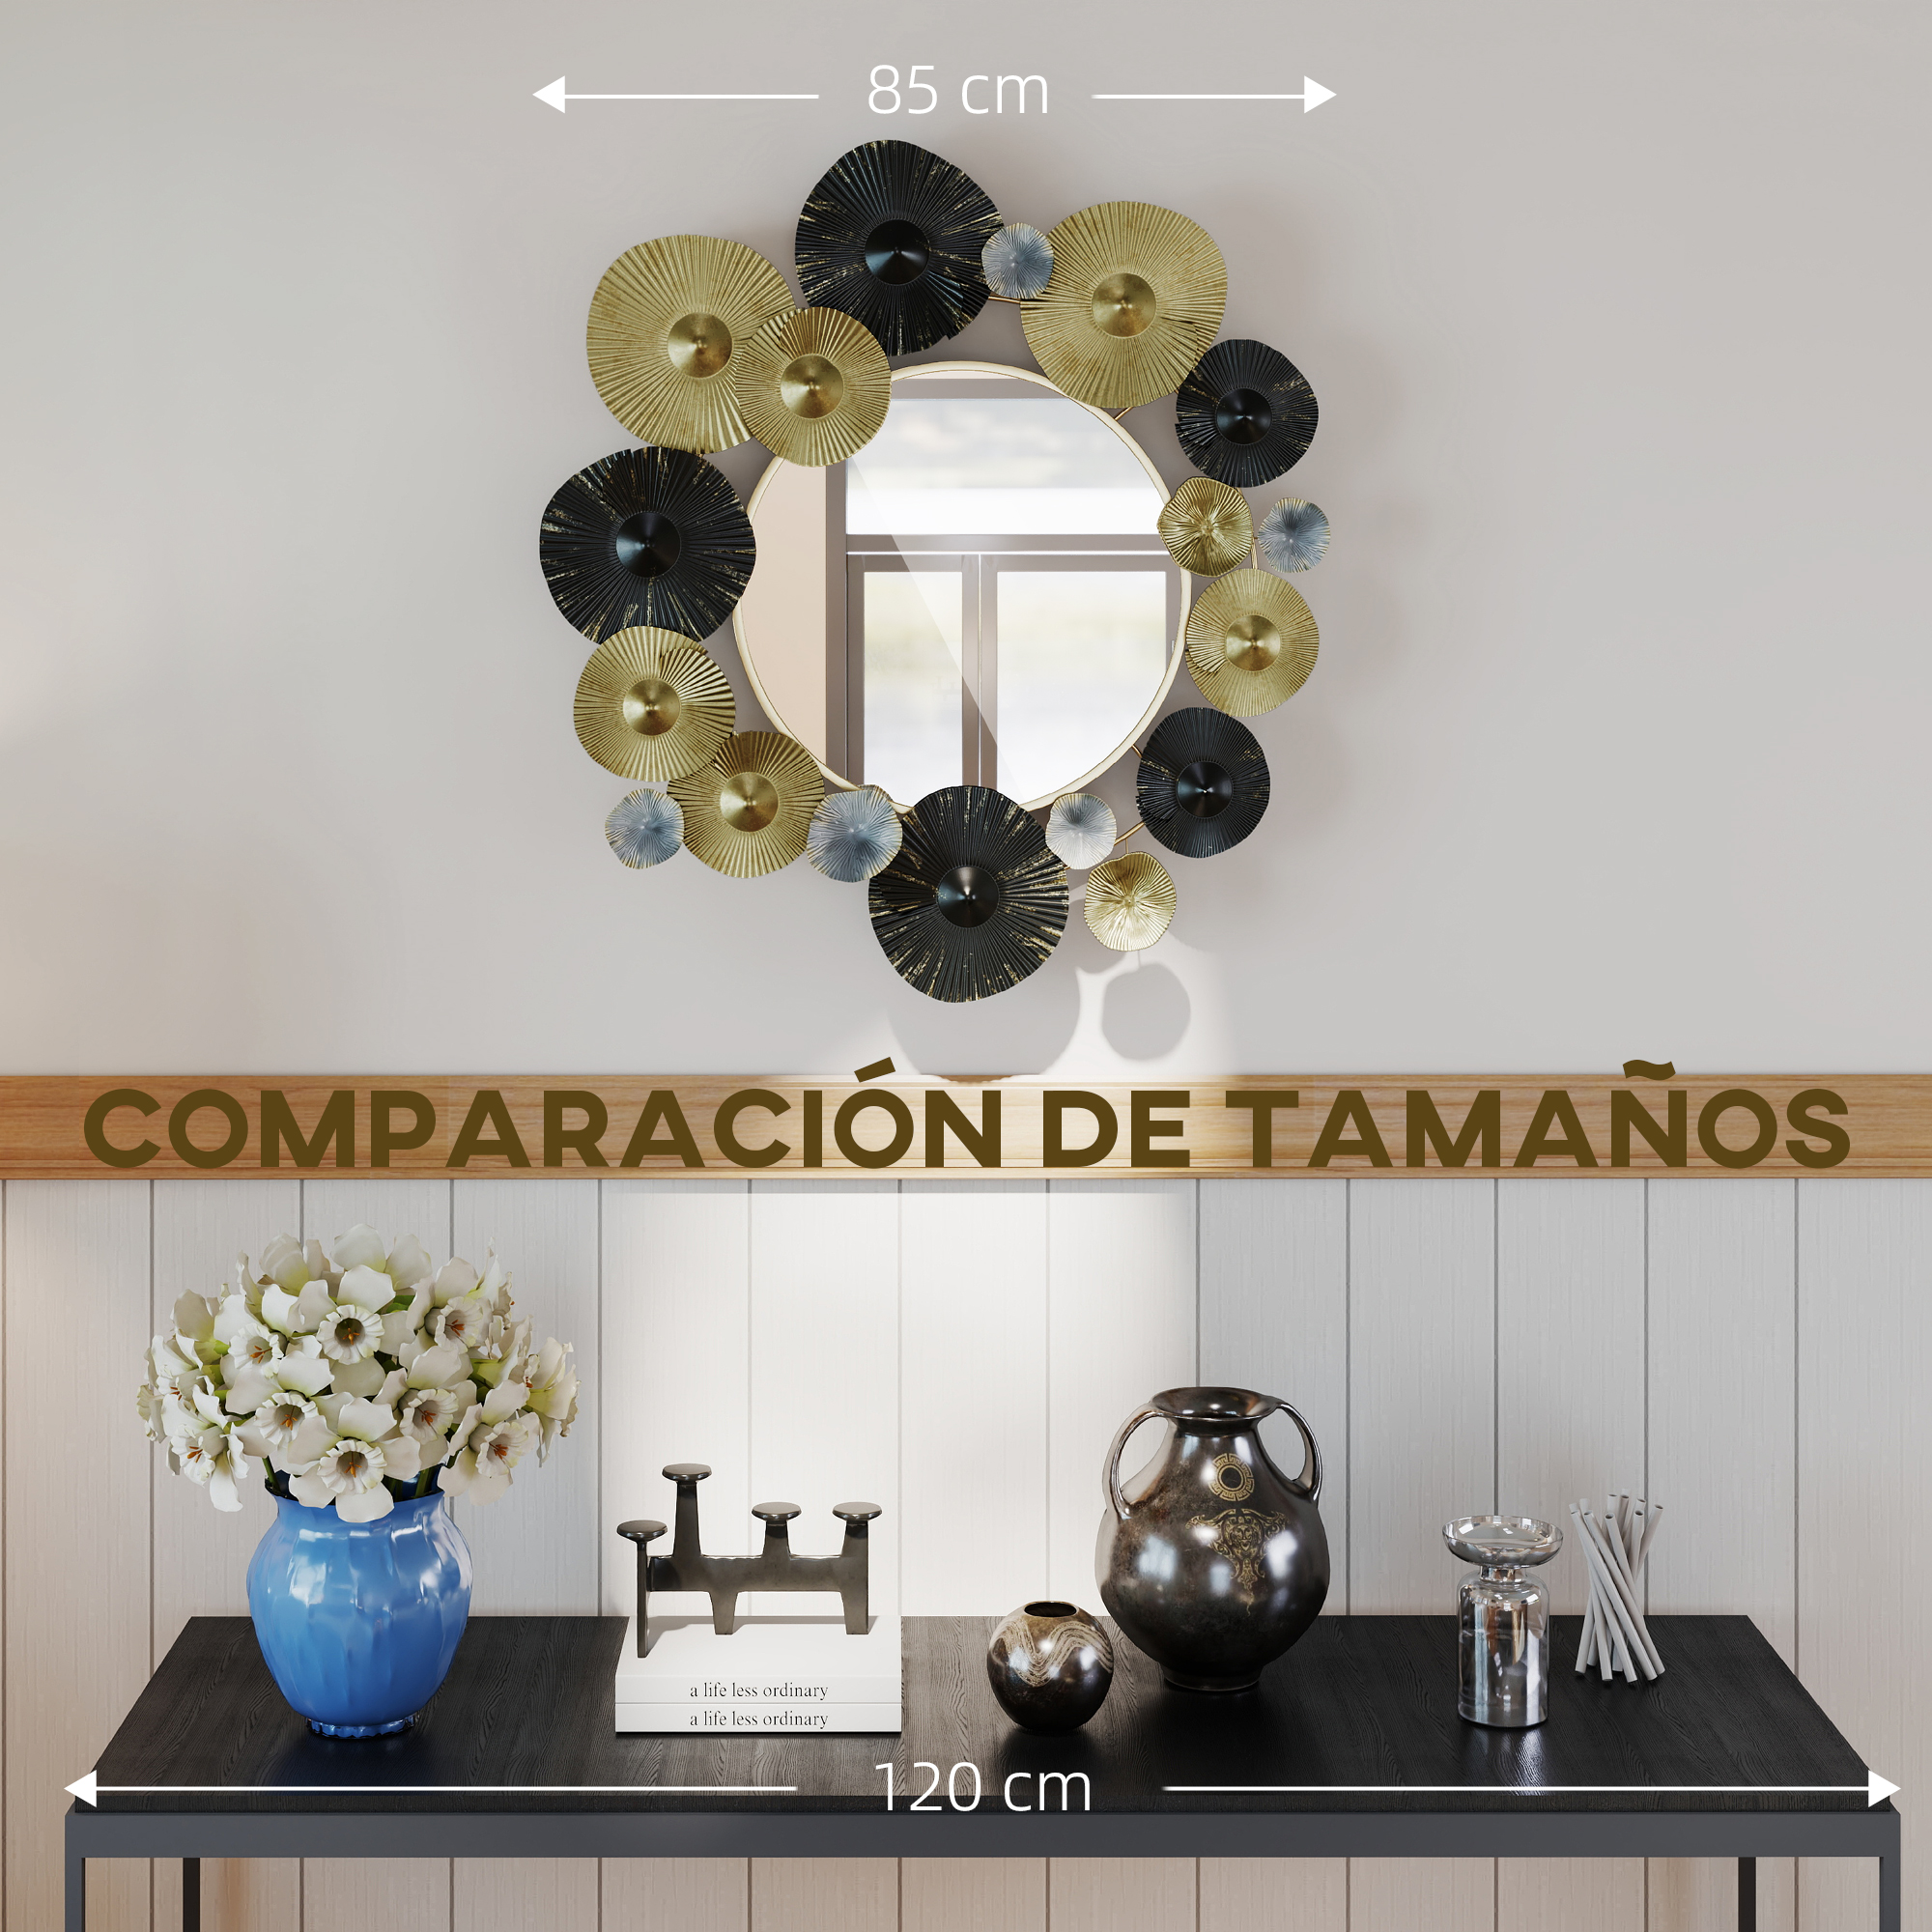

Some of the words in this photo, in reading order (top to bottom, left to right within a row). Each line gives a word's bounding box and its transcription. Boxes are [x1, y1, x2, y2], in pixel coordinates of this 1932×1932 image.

[690, 1687, 698, 1697] a
[703, 1682, 727, 1697] life
[732, 1682, 758, 1697] less
[762, 1682, 829, 1701] ordinary
[690, 1715, 698, 1726] a
[703, 1710, 727, 1726] life
[732, 1710, 758, 1726] less
[762, 1710, 829, 1730] ordinary
